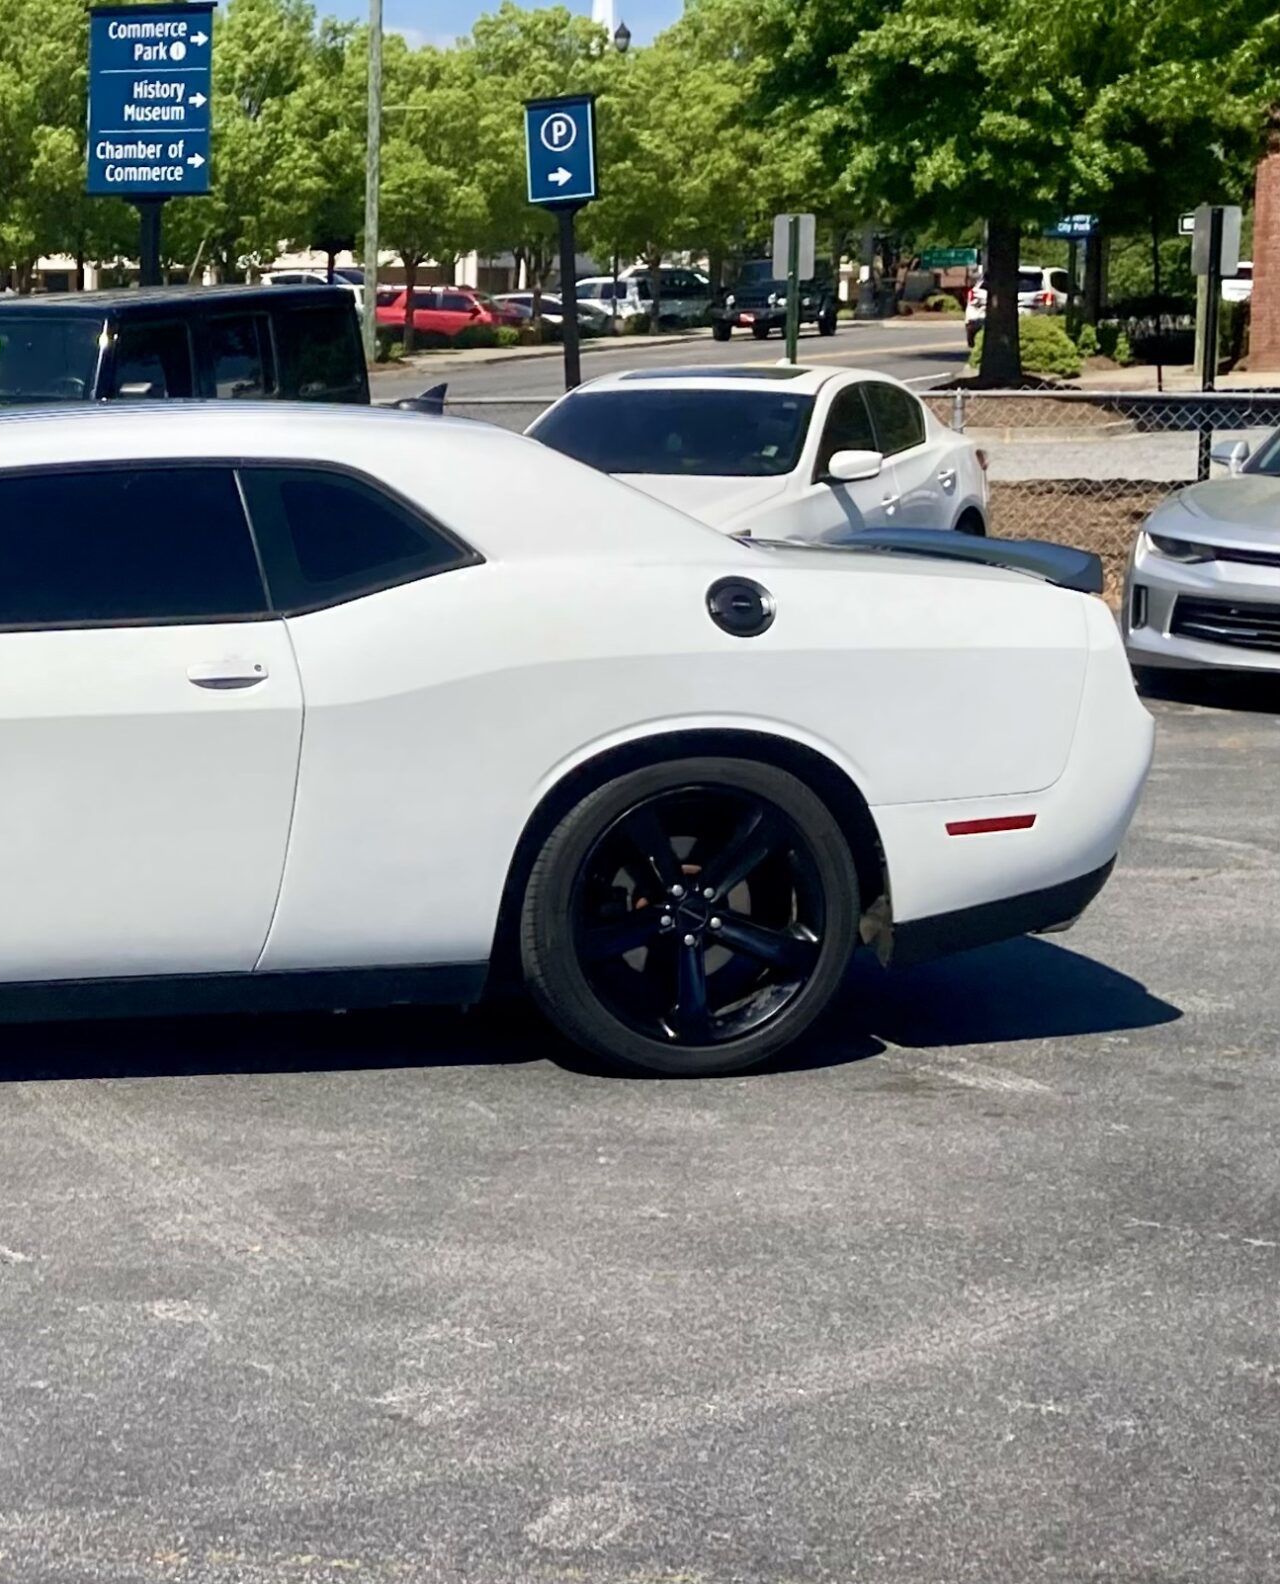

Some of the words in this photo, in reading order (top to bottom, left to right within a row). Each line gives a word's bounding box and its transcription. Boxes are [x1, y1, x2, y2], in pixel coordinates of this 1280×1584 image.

[108, 21, 188, 40] Commerce
[134, 42, 167, 62] Park
[133, 79, 185, 103] History
[123, 104, 185, 122] Museum
[96, 140, 163, 160] Chamber
[168, 139, 185, 158] of
[105, 164, 184, 182] Commerce
